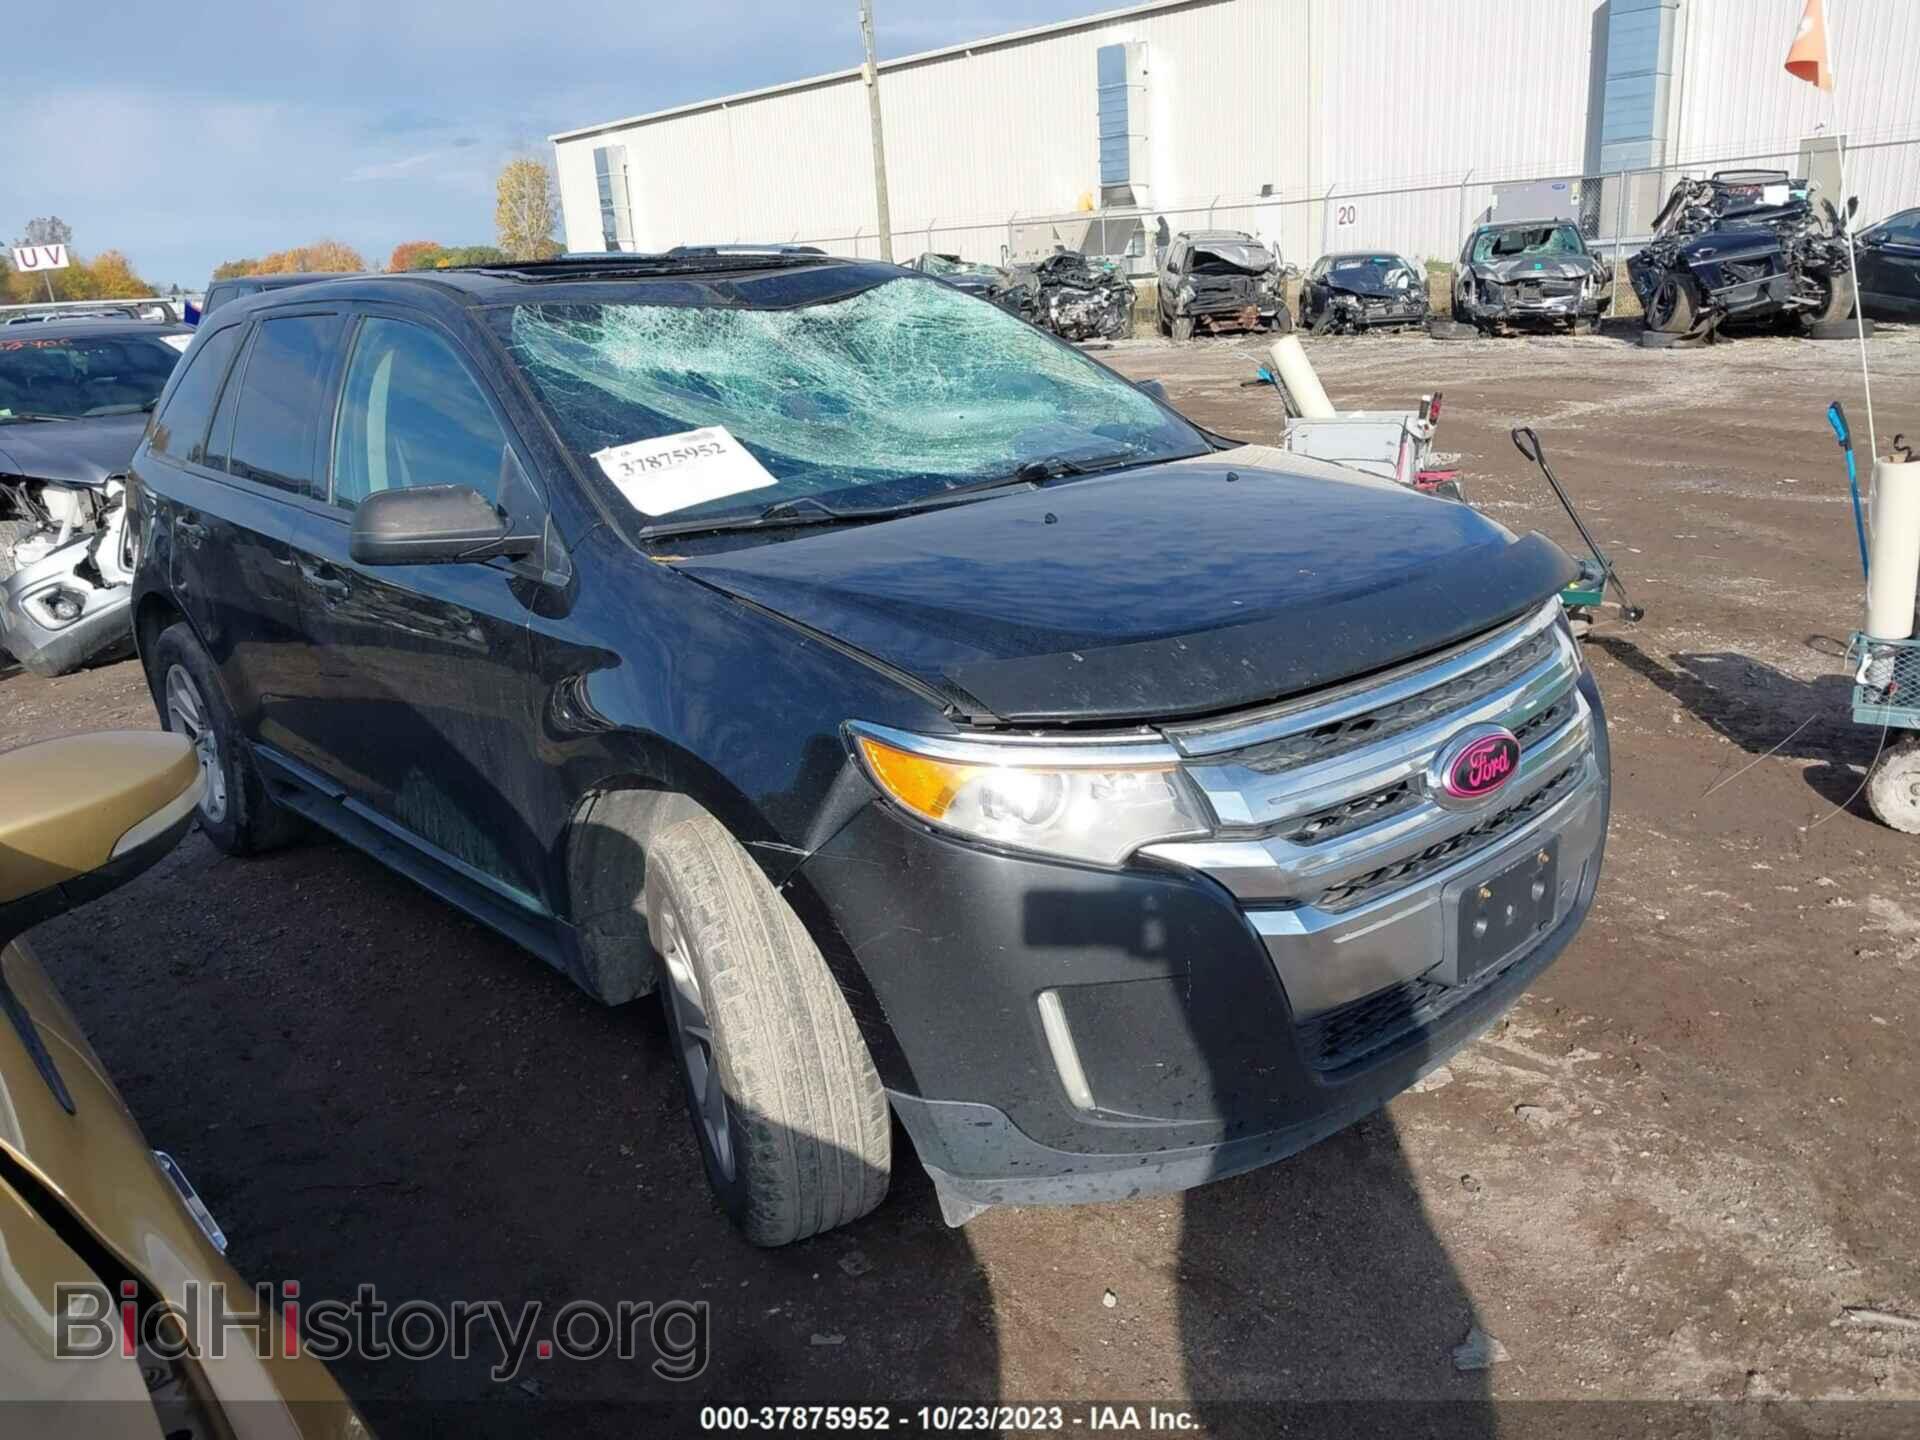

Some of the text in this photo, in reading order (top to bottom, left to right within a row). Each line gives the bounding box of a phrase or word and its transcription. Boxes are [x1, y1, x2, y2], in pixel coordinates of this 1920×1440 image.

[1338, 206, 1356, 225] 20
[618, 442, 727, 477] 37875952
[1469, 744, 1510, 787] Ford
